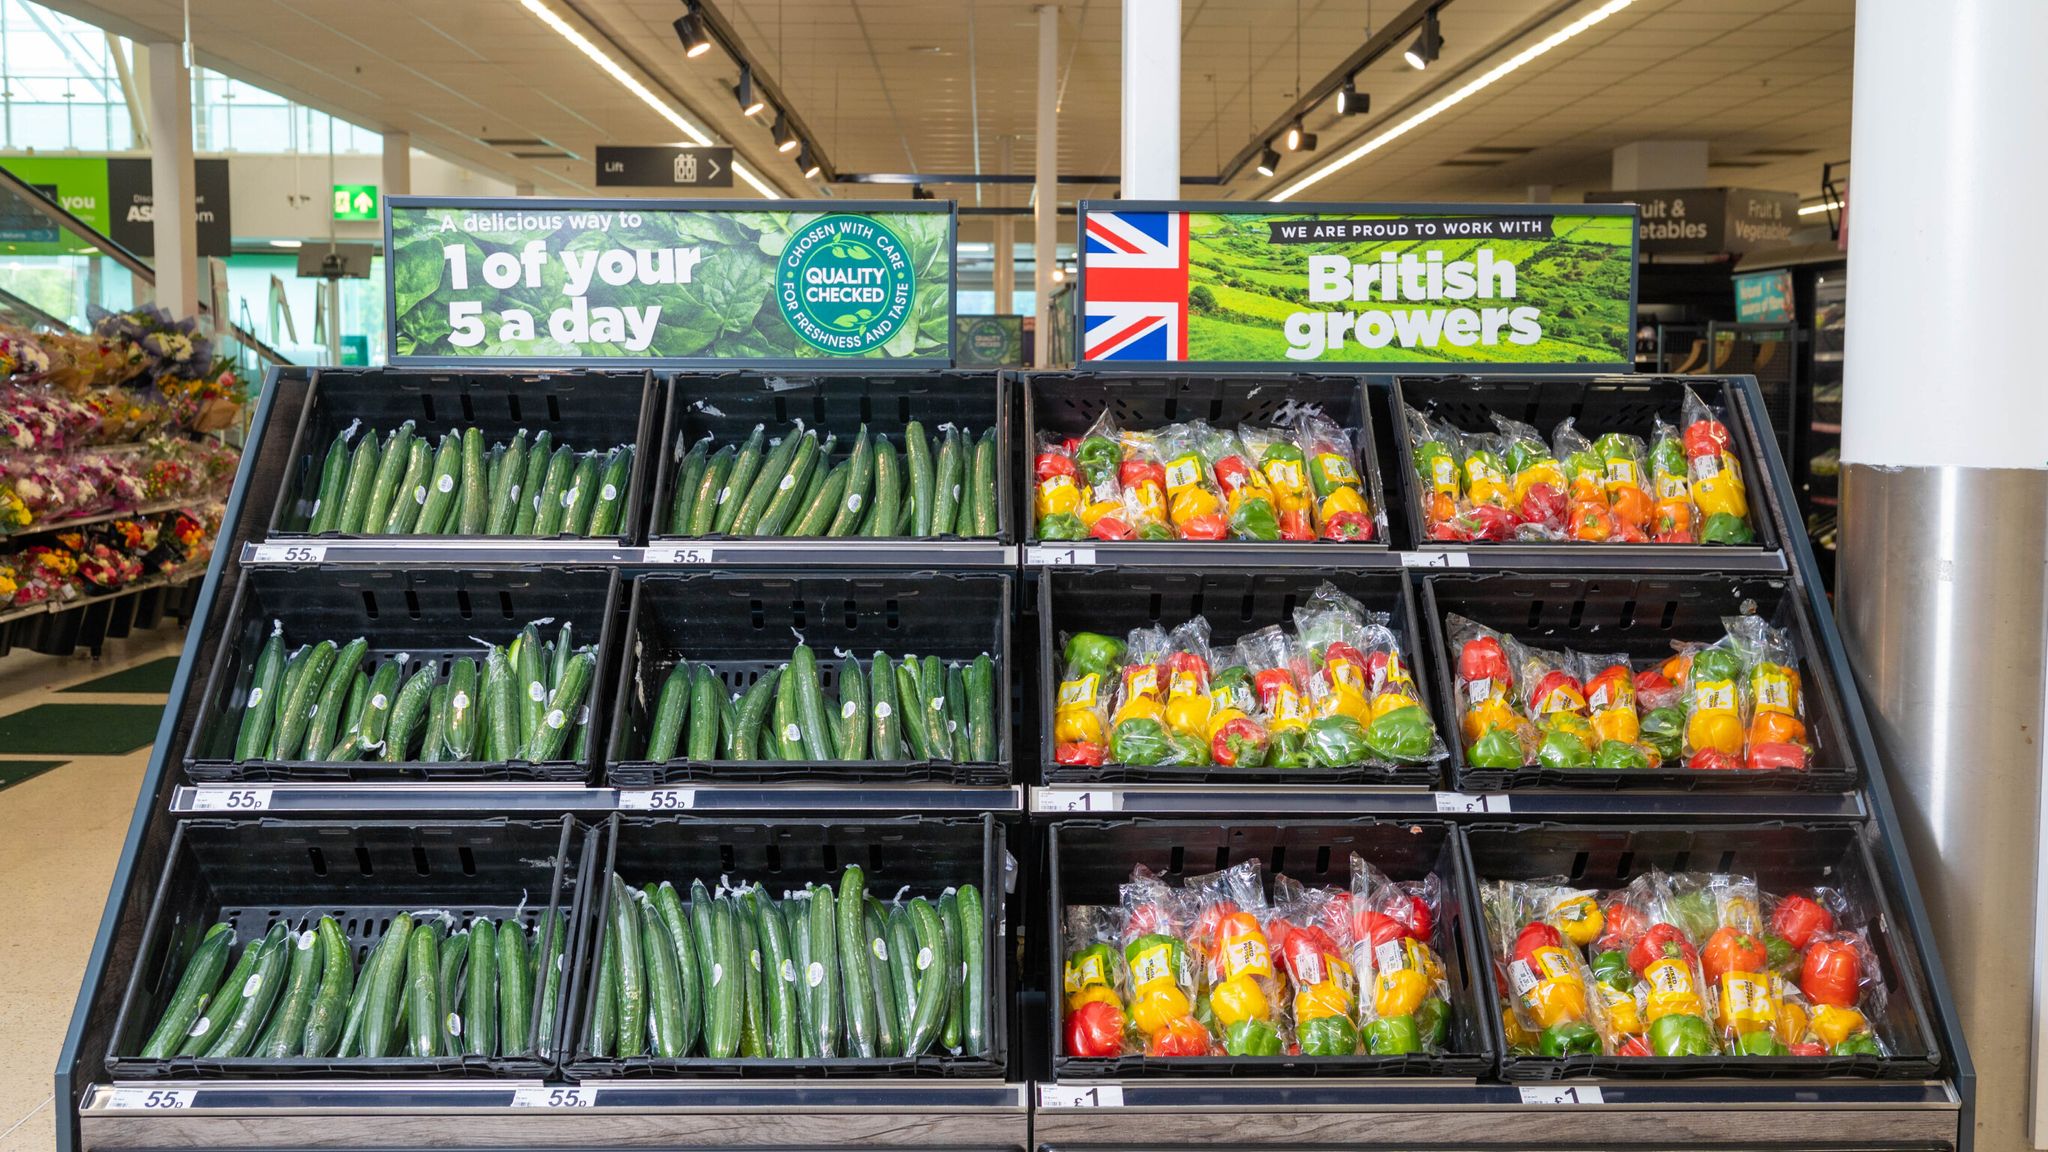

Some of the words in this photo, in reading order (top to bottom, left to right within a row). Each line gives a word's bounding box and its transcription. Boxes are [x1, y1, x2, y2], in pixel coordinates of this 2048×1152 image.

[605, 162, 624, 172] Lift
[61, 195, 96, 210] you
[1640, 199, 1667, 218] uit
[1671, 199, 1685, 217] &
[440, 215, 457, 232] A
[464, 212, 562, 233] delicious
[568, 213, 612, 231] way
[619, 211, 642, 229] to
[1281, 226, 1307, 238] WE
[1313, 225, 1346, 237] ARE
[1353, 224, 1409, 237] PROUD
[1415, 223, 1437, 235] TO
[1443, 222, 1493, 235] WORK
[1500, 221, 1542, 234] WITH
[1640, 220, 1707, 239] etables
[787, 223, 836, 268] CHOSEN
[839, 221, 874, 239] WITH
[876, 236, 905, 270] CARE
[443, 243, 468, 290] 1
[482, 240, 548, 290] of
[559, 246, 701, 297] your
[806, 267, 885, 285] QUALITY
[1308, 249, 1516, 303] British
[806, 287, 885, 303] CHECKED
[447, 301, 486, 348] 5
[500, 308, 535, 343] a
[548, 296, 662, 351] day
[783, 282, 799, 311] FOR
[793, 311, 862, 348] FRESHNESS
[866, 319, 892, 344] AND
[888, 283, 909, 320] TASTE
[1284, 306, 1542, 360] growers
[284, 547, 317, 561] 55p
[227, 791, 262, 809] 55p
[650, 791, 685, 809] 55p
[1067, 793, 1090, 810] £1
[1466, 794, 1488, 812] £1
[145, 1091, 183, 1109] 55p
[548, 1090, 586, 1107] 55p
[1074, 1088, 1098, 1106] £1
